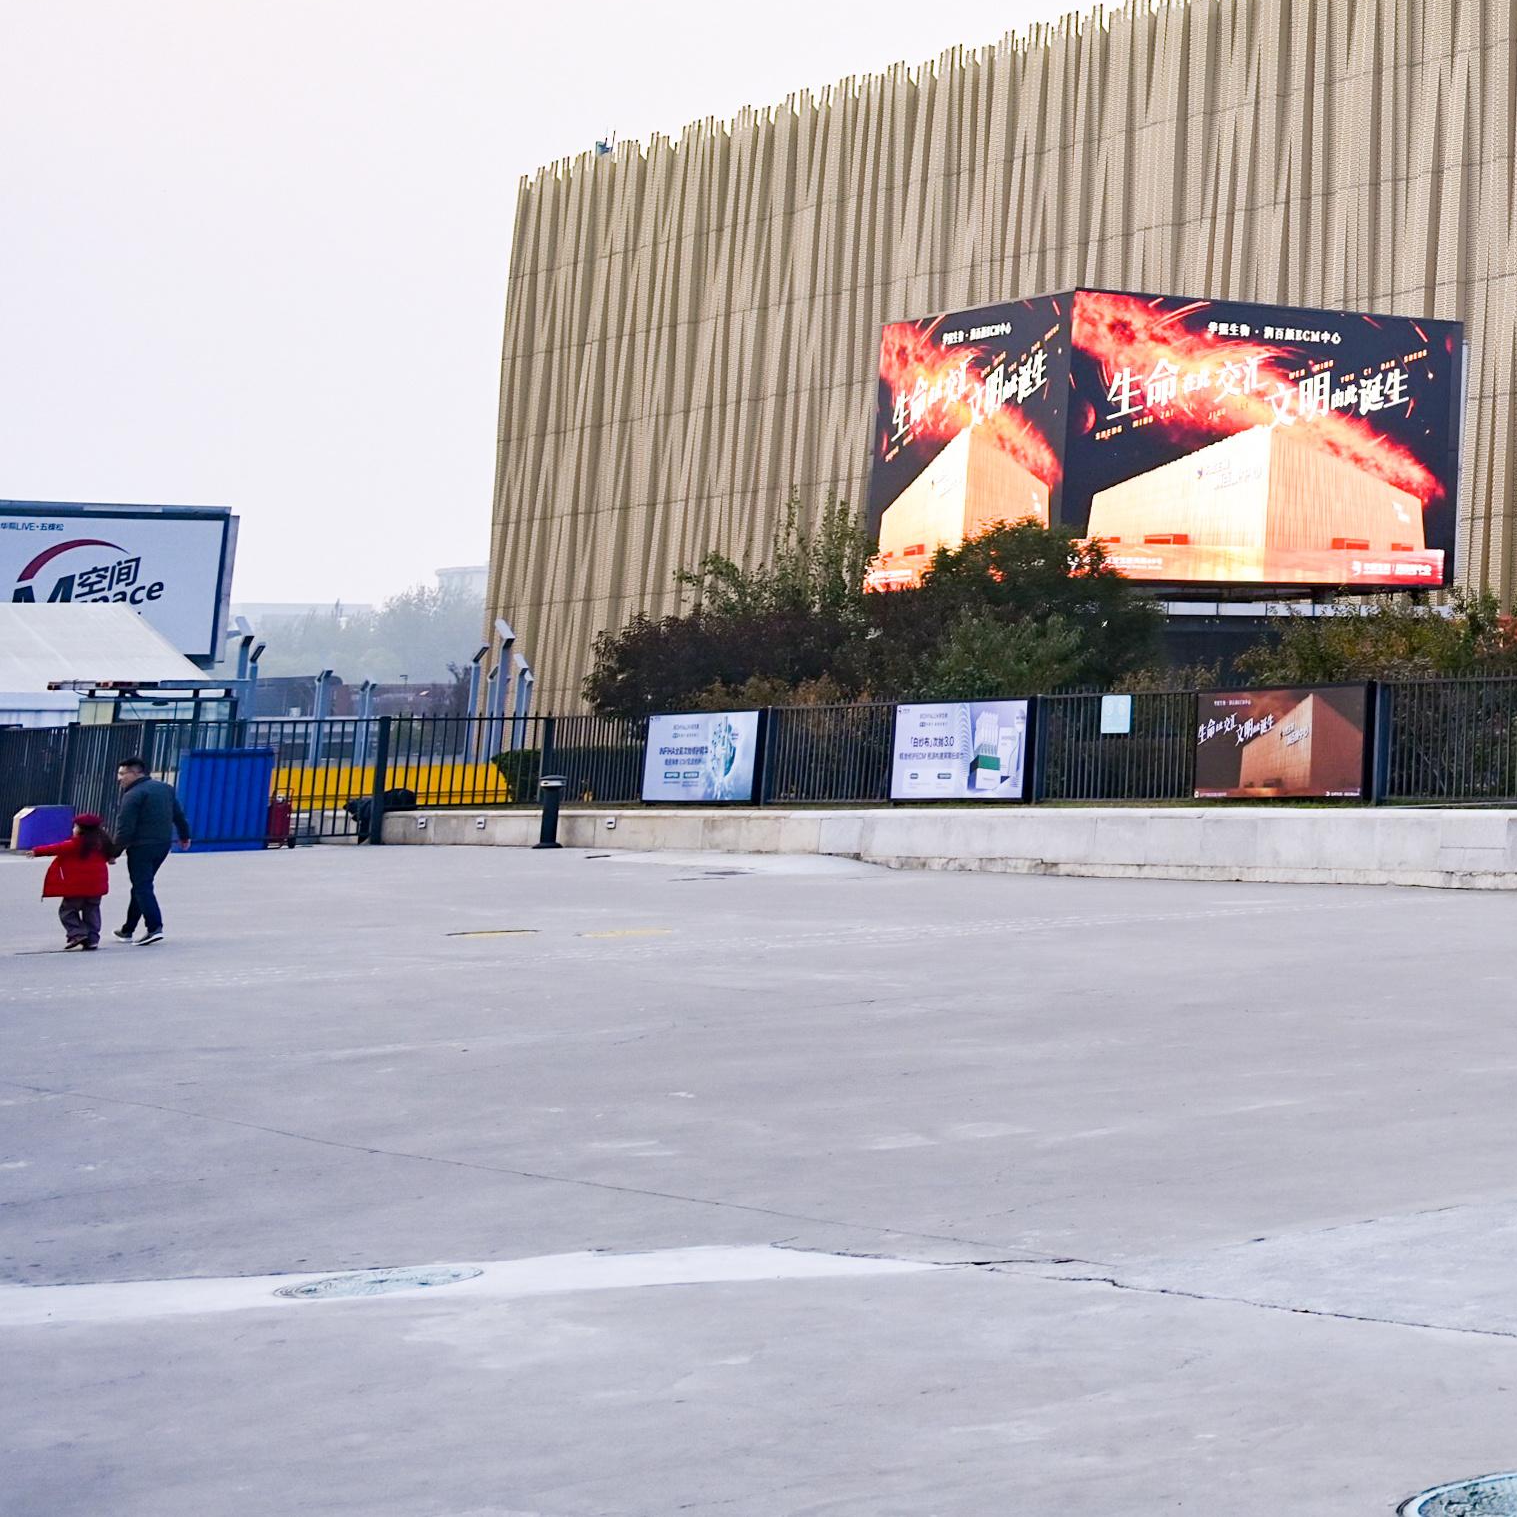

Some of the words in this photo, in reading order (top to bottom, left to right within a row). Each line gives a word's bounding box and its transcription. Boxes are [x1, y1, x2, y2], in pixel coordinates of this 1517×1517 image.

[1264, 368, 1409, 427] 文明由此诞生
[75, 556, 141, 599] 空间
